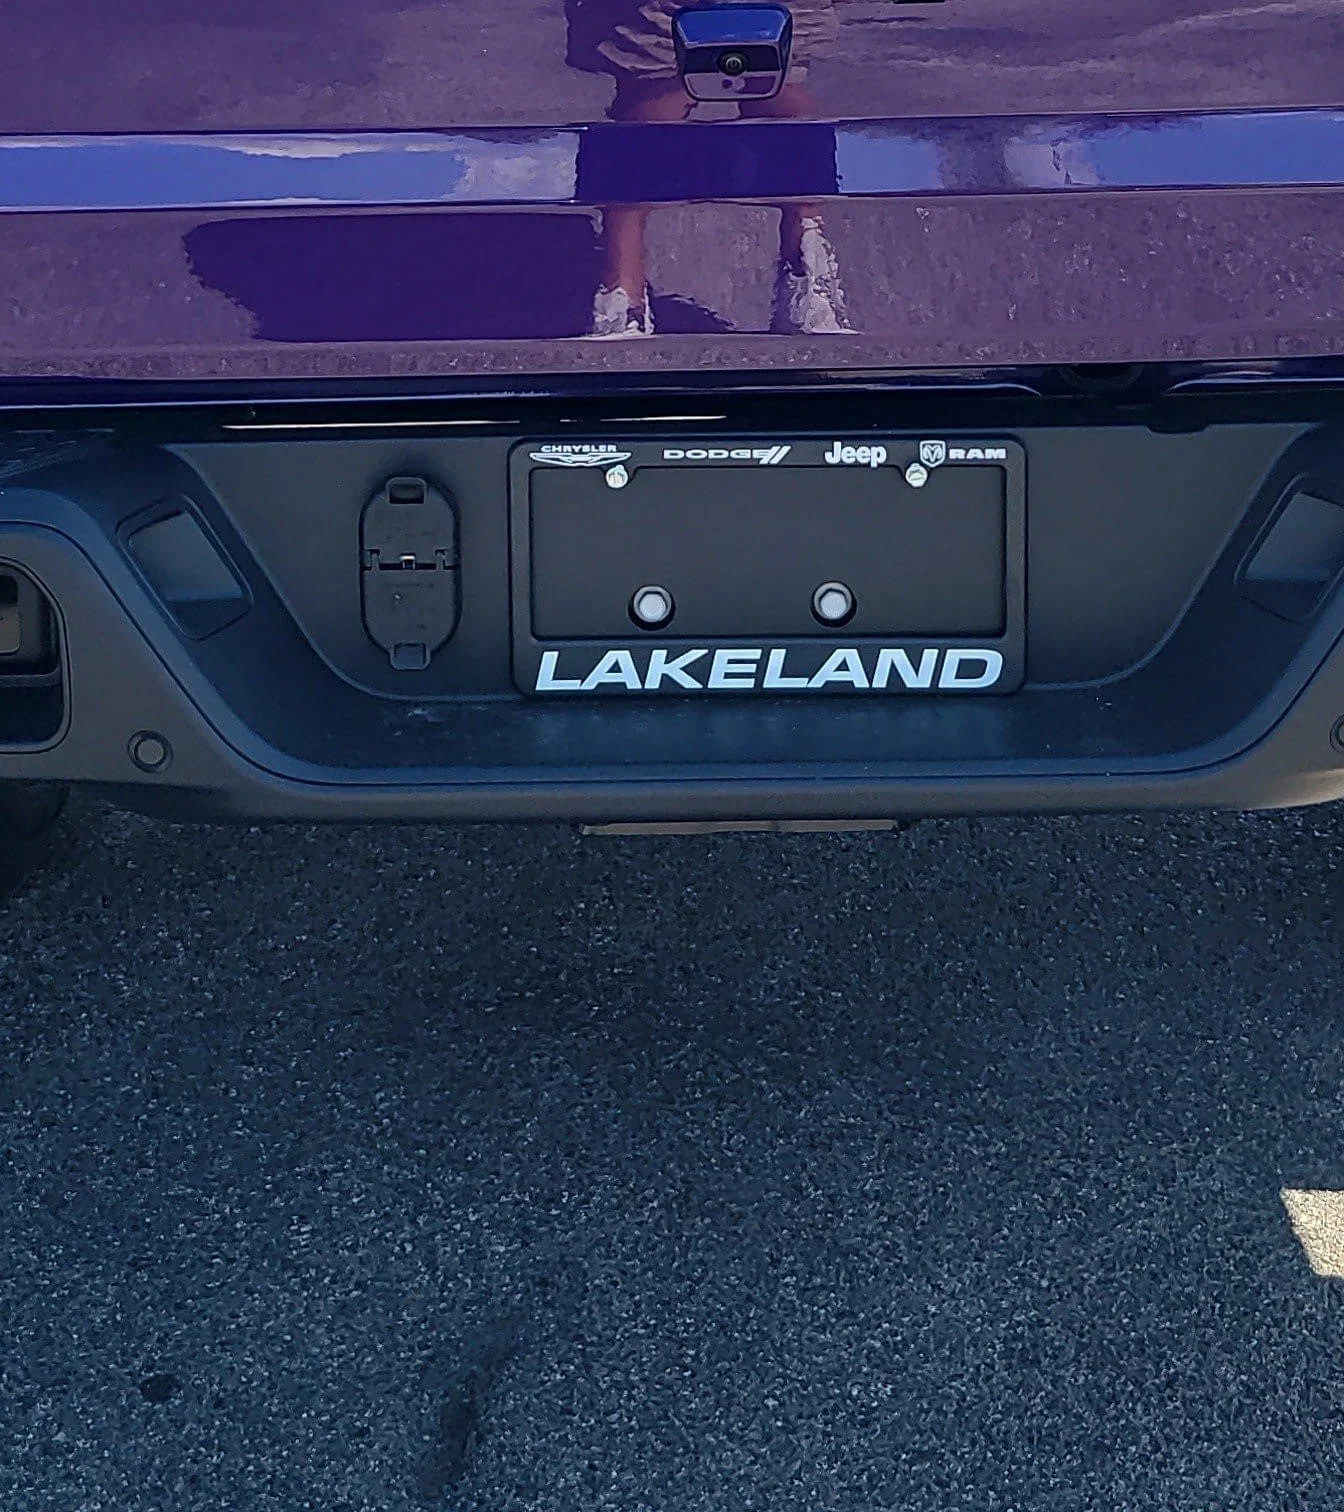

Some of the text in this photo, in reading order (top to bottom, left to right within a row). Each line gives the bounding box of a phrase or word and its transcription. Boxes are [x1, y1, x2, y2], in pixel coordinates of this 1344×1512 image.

[541, 444, 618, 453] CHRYSLER
[663, 449, 768, 460] DODGE
[825, 441, 887, 468] Jeep
[949, 448, 1006, 460] RAM
[535, 649, 1003, 690] LAKELAND
